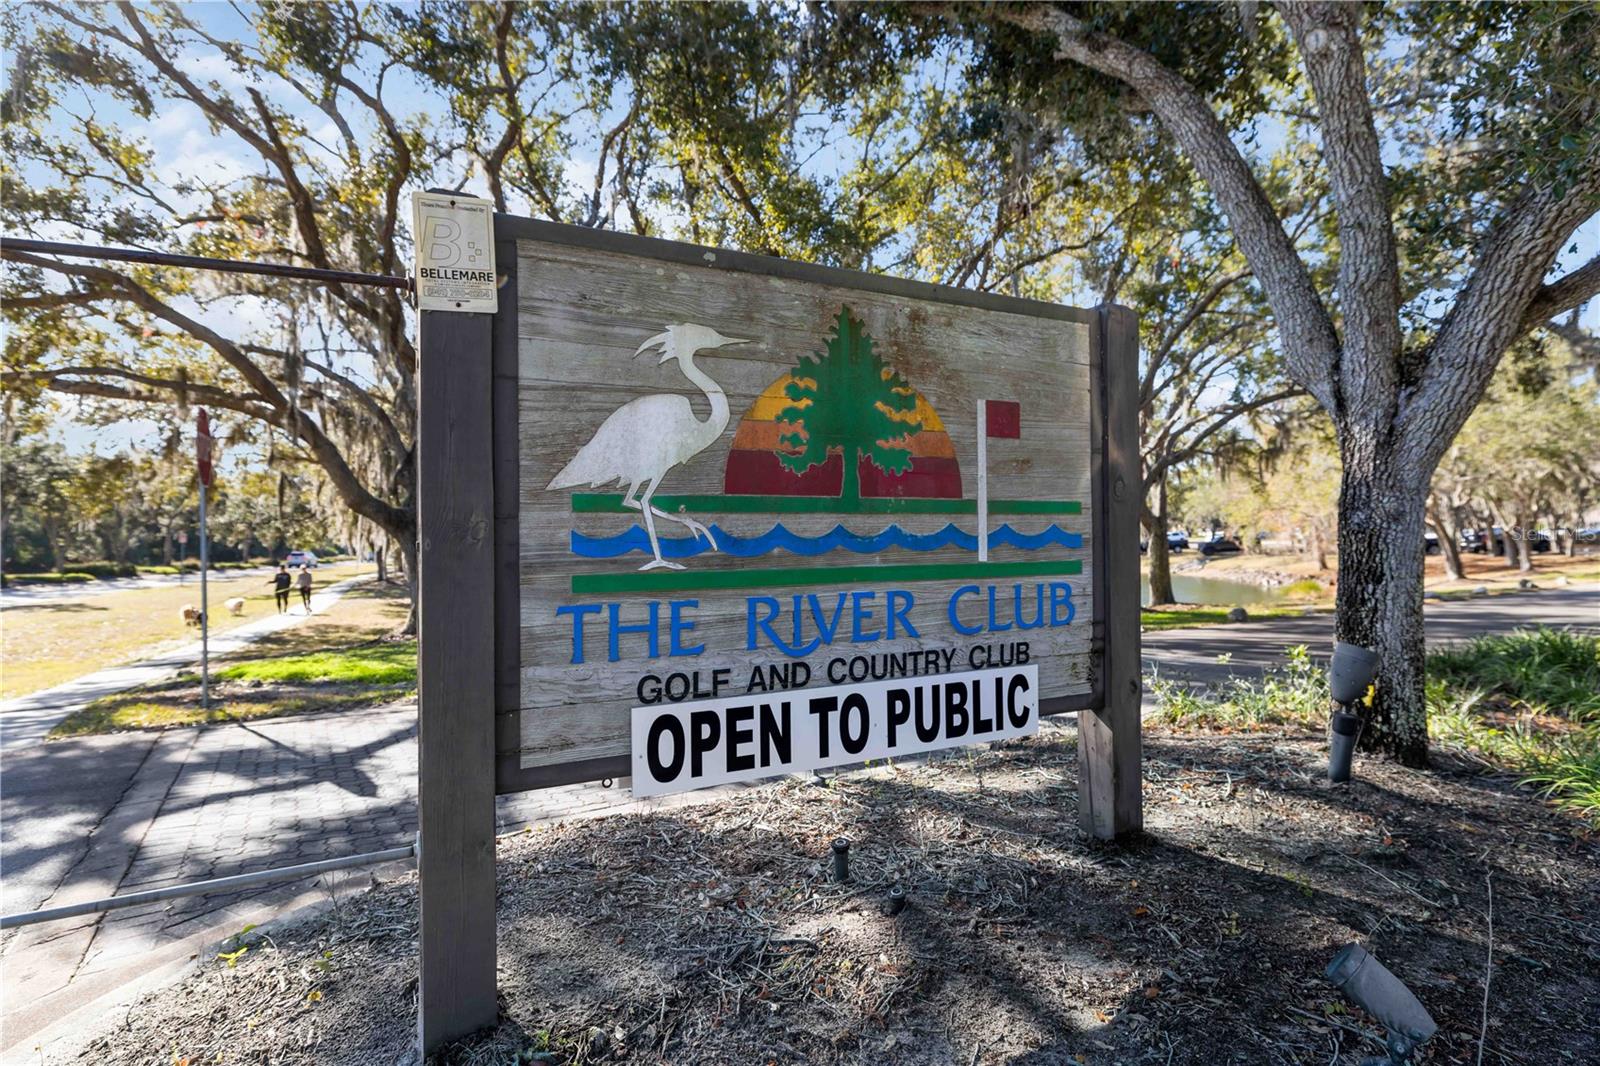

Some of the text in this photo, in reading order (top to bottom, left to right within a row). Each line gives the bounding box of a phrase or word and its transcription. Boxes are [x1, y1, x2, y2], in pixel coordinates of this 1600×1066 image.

[420, 267, 494, 282] BELLEMARE
[556, 582, 1076, 664] THE RIVER CLUB
[637, 641, 1031, 704] GOLF AND COUNTRY CLUB
[647, 673, 1032, 784] OPEN TO PUBLIC
